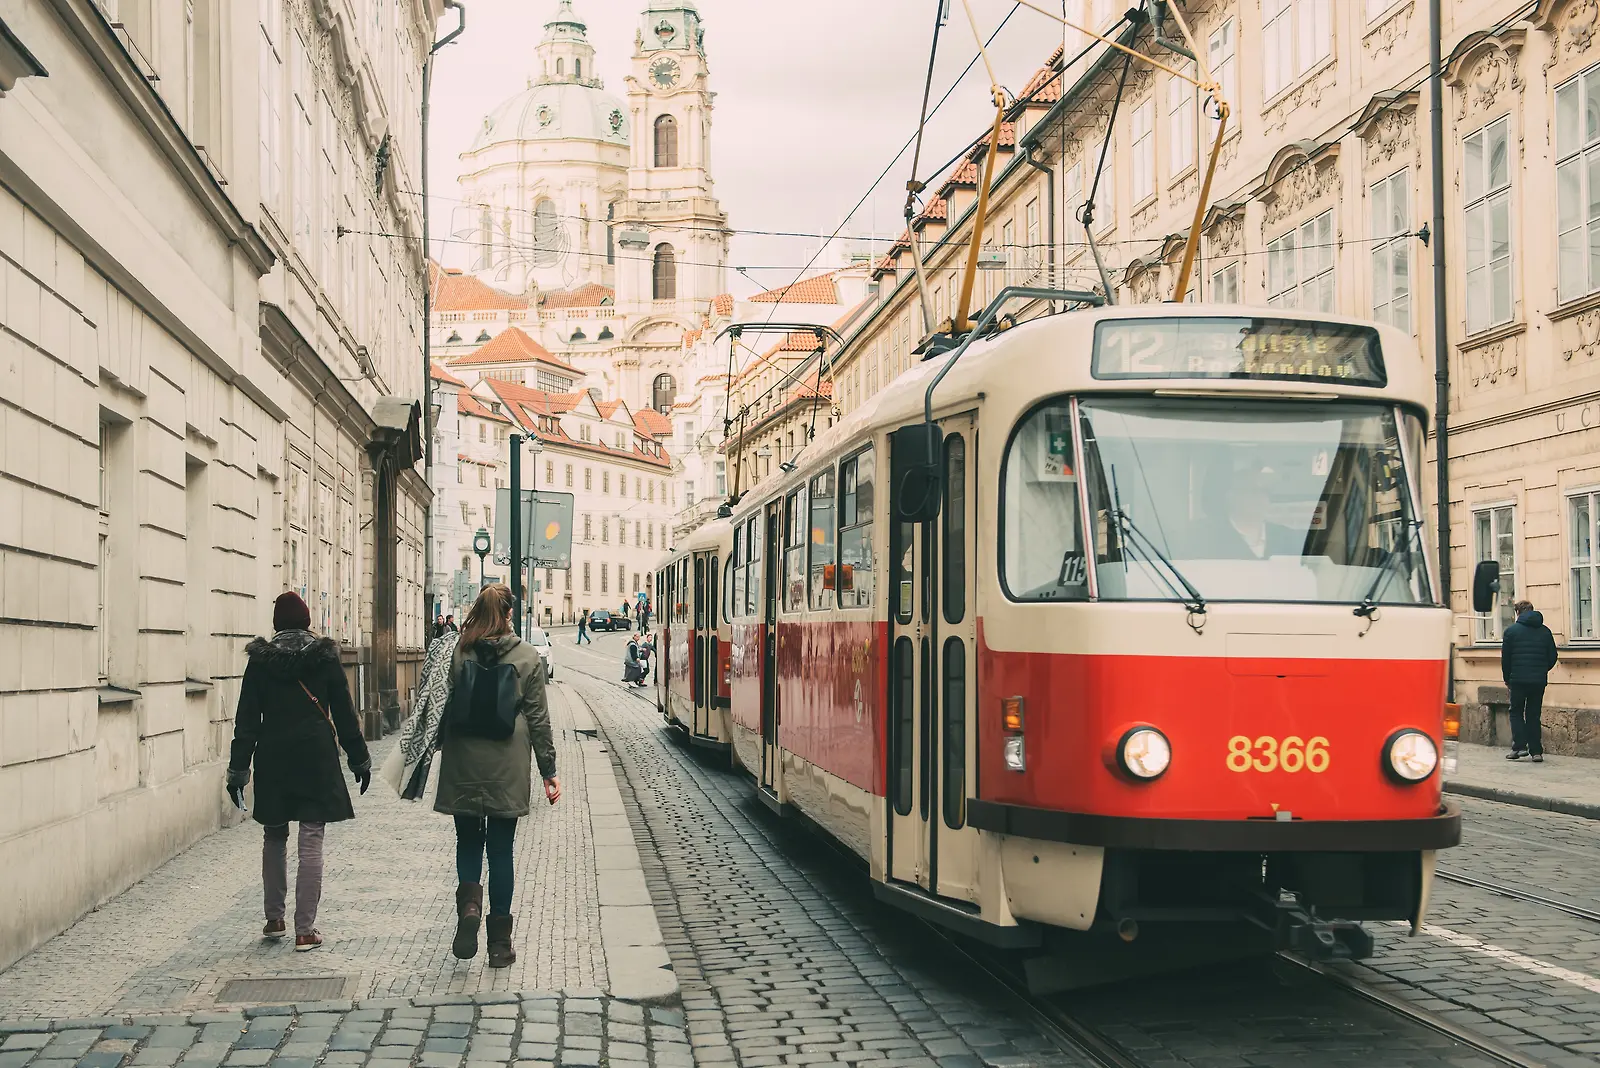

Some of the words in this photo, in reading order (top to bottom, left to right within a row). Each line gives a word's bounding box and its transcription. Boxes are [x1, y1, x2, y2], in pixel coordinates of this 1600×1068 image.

[1106, 329, 1164, 372] 12
[1187, 356, 1351, 379] Barandov
[1226, 735, 1330, 773] 8366
